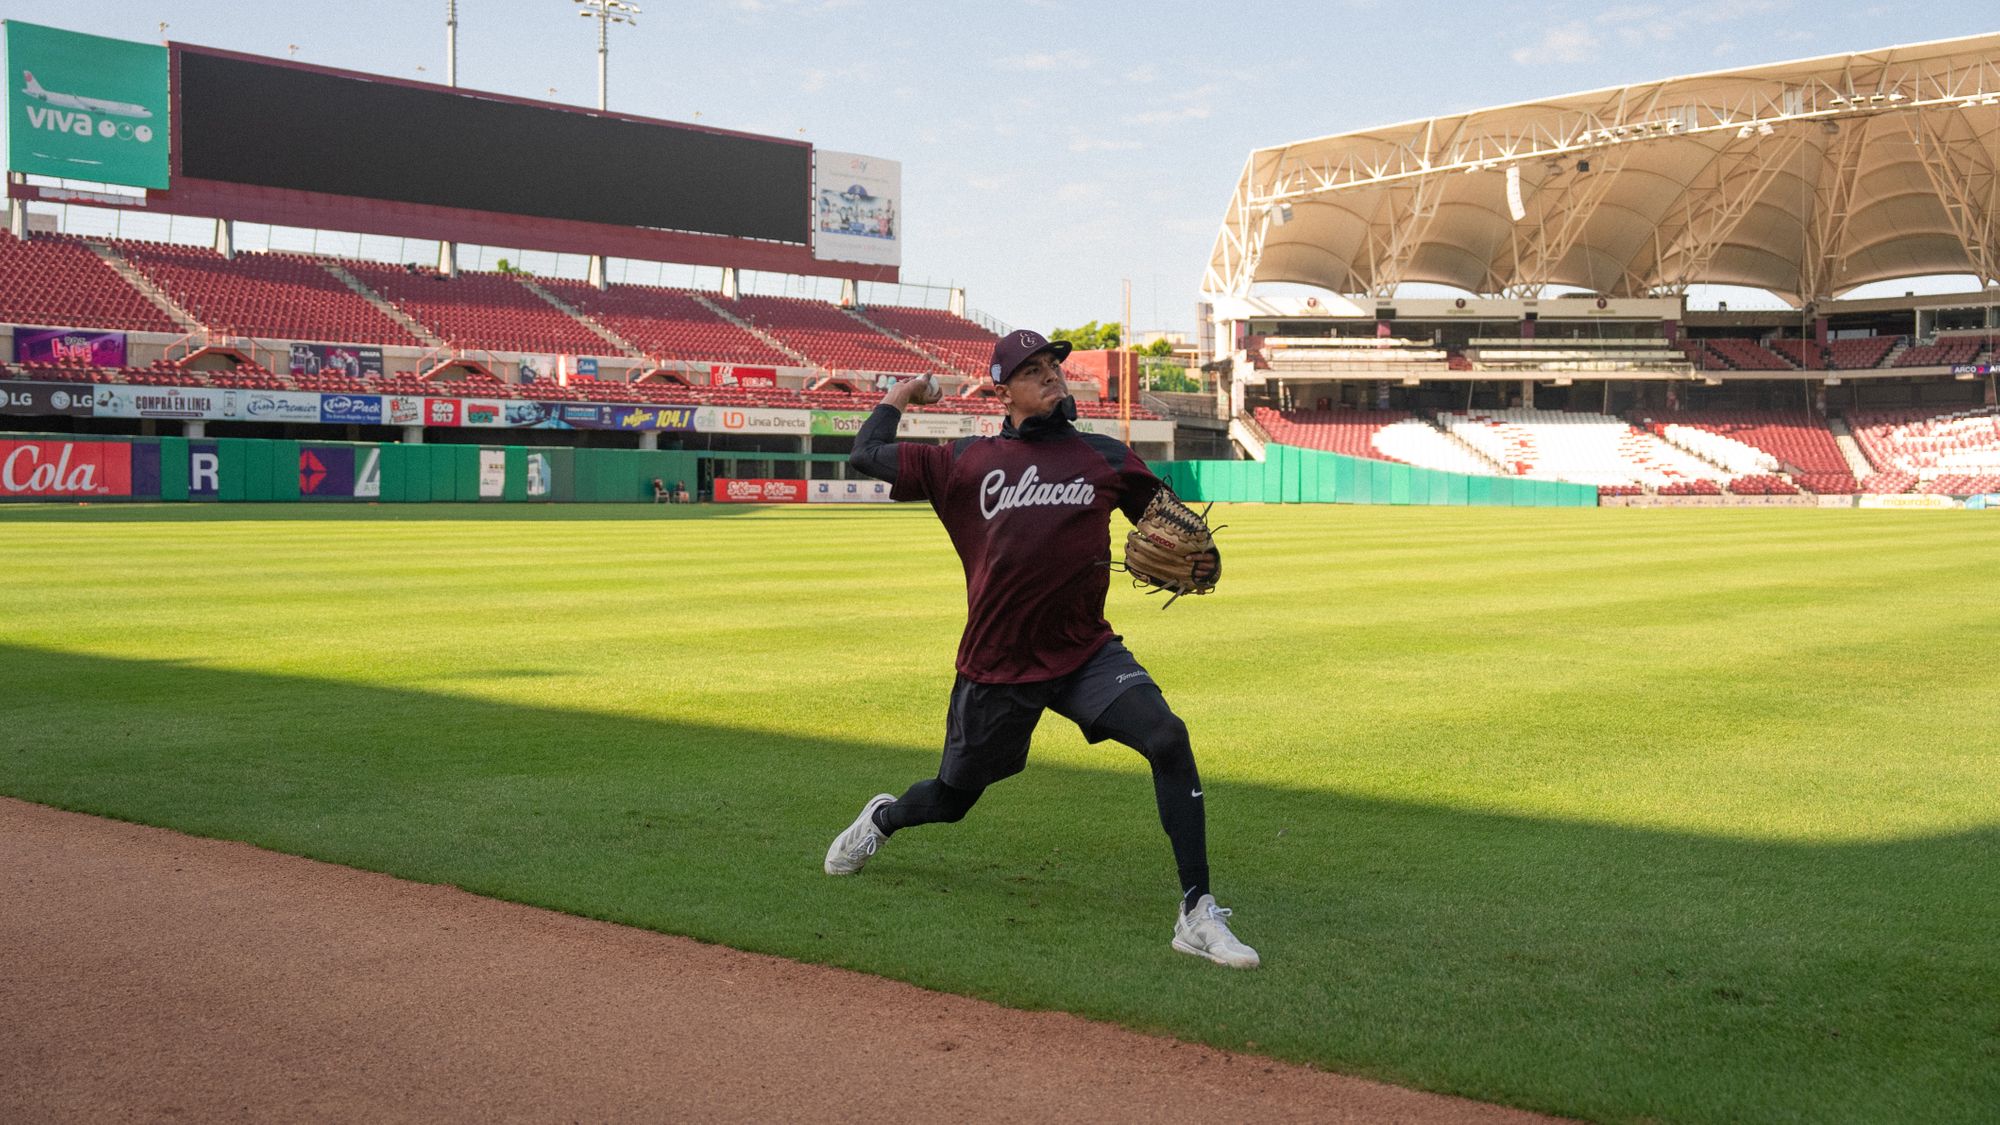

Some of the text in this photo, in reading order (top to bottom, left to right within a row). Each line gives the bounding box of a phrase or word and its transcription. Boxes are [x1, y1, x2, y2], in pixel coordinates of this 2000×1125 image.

[1954, 365, 1977, 374] ARCO
[11, 392, 32, 406] LG
[72, 394, 93, 408] LG
[136, 396, 173, 411] COMPRA
[175, 396, 185, 411] EN
[276, 399, 318, 413] Premier
[352, 400, 381, 414] Pack
[656, 409, 690, 428] 104.1
[773, 416, 806, 429] Directa
[2, 443, 98, 492] Cola
[980, 465, 1096, 520] Culiacán
